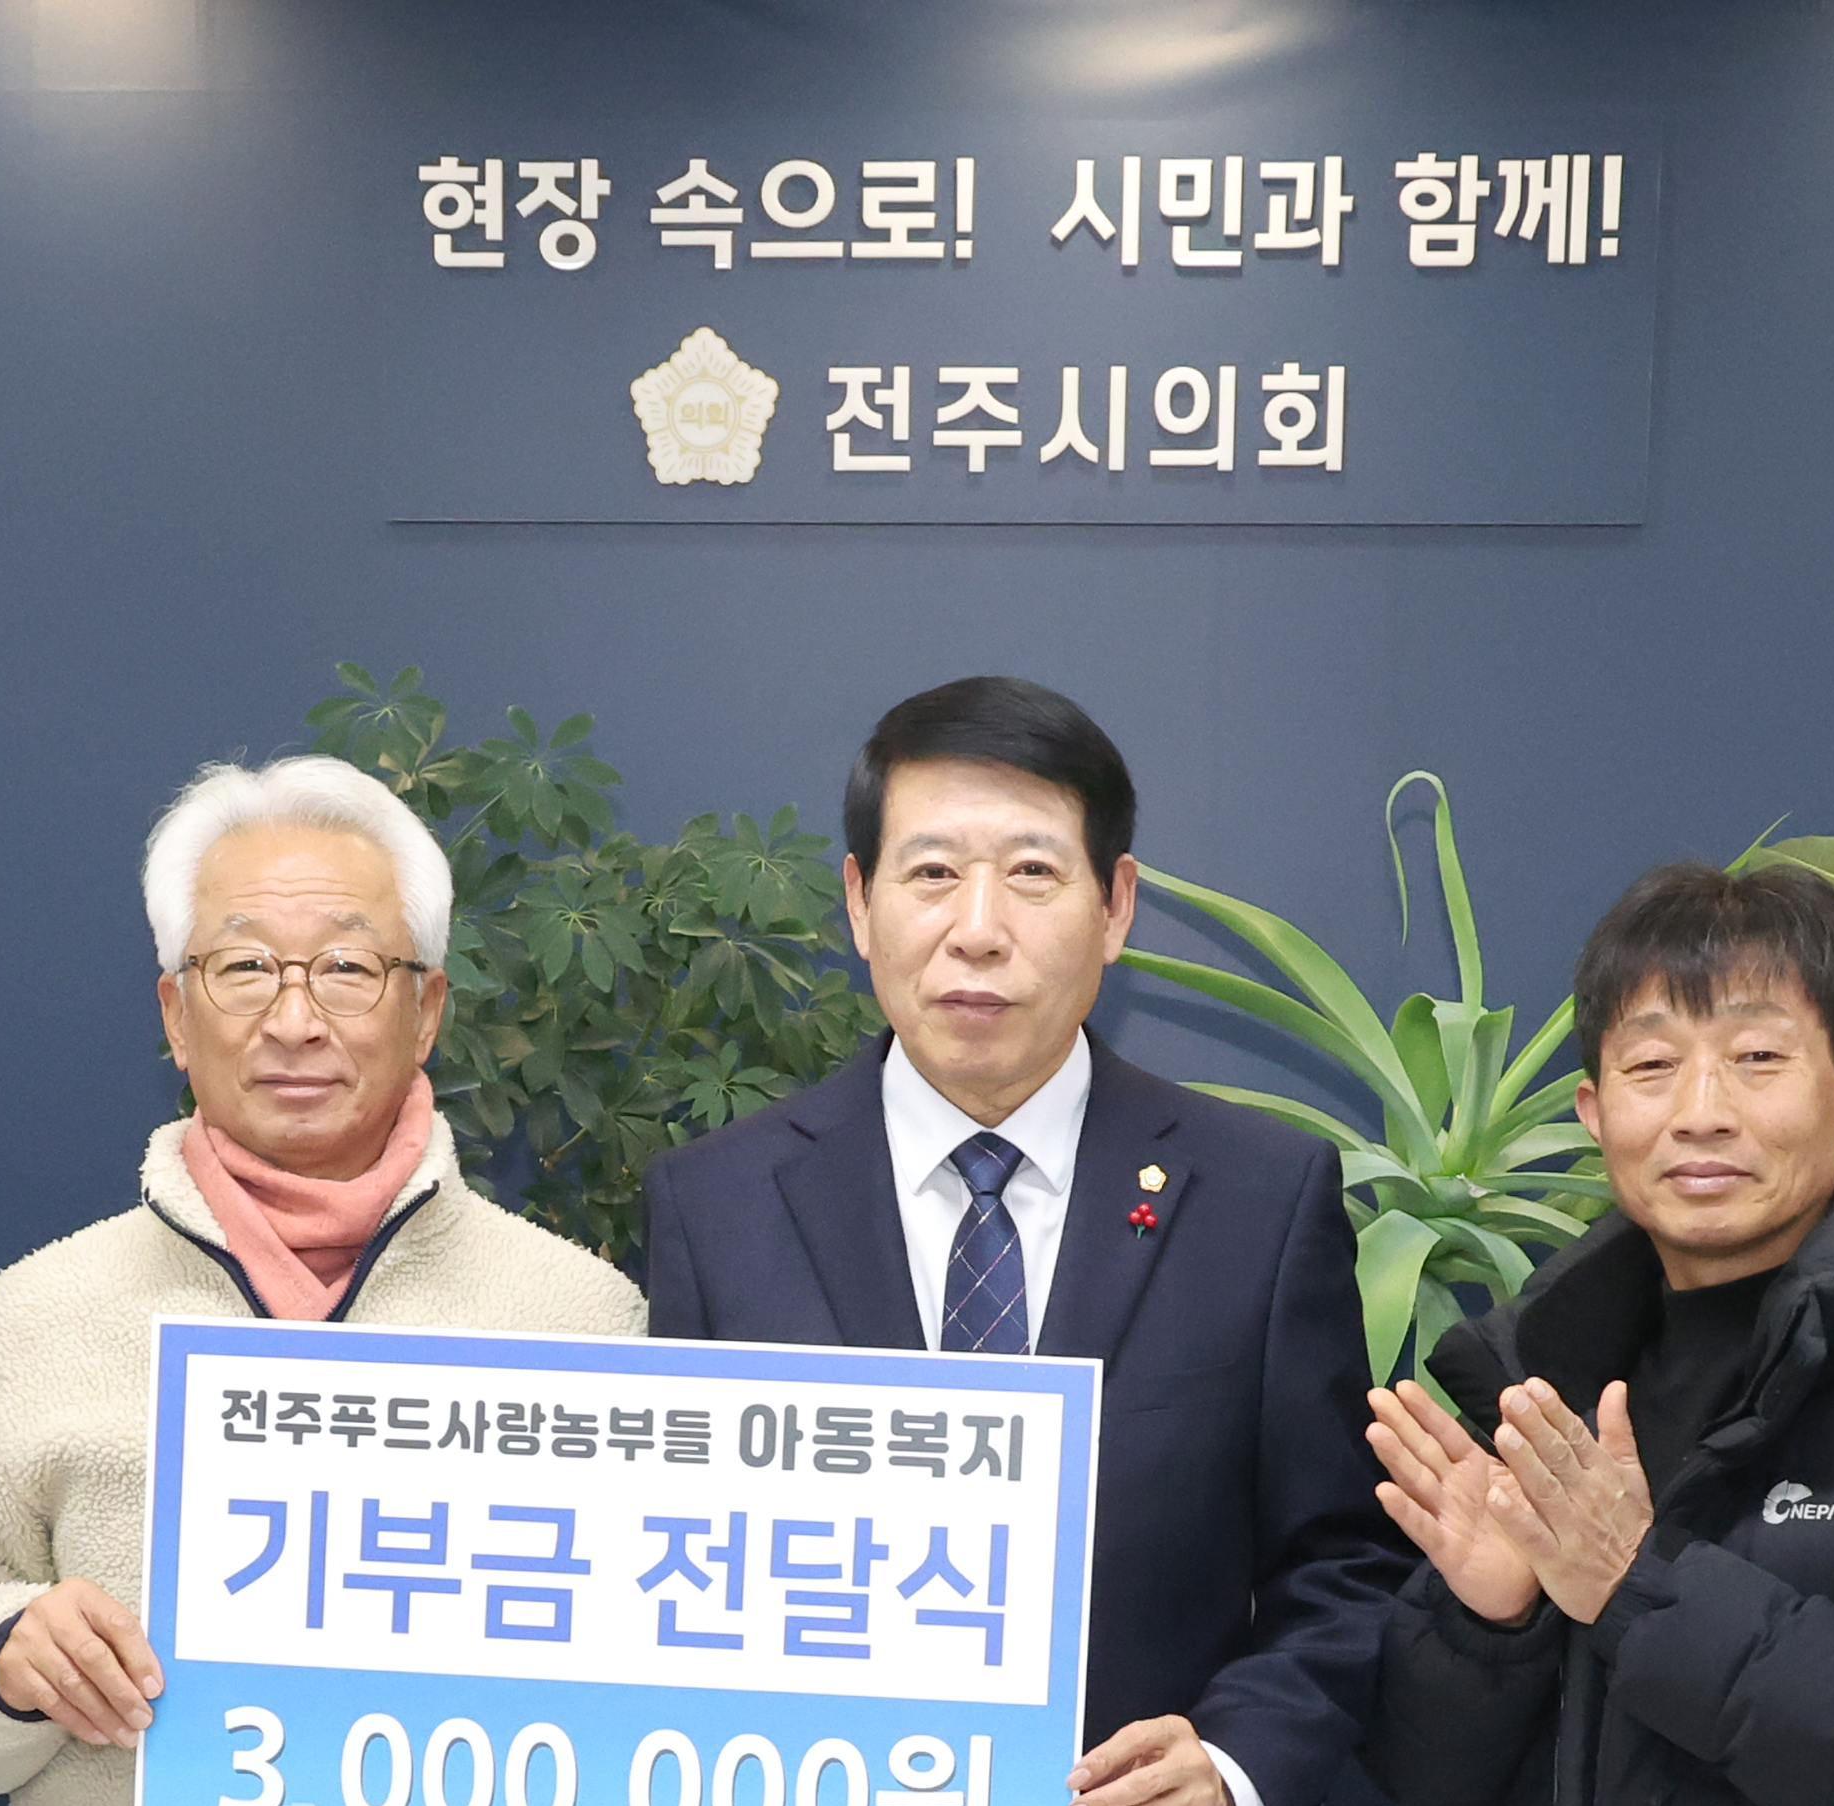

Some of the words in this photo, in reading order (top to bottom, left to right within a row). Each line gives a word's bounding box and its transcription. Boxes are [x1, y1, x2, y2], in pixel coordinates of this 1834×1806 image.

[418, 156, 611, 271] 현장
[650, 157, 975, 270] 속으로!
[1050, 155, 1354, 267] 시민과
[1394, 152, 1623, 267] 함께!
[679, 400, 730, 431] 의회
[825, 362, 1346, 473] 전주시의회
[220, 1388, 713, 1466] 전주푸드사랑농부들
[738, 1403, 1025, 1483] 아동복지
[223, 1490, 592, 1643] 기부금
[636, 1511, 1010, 1667] 전달식
